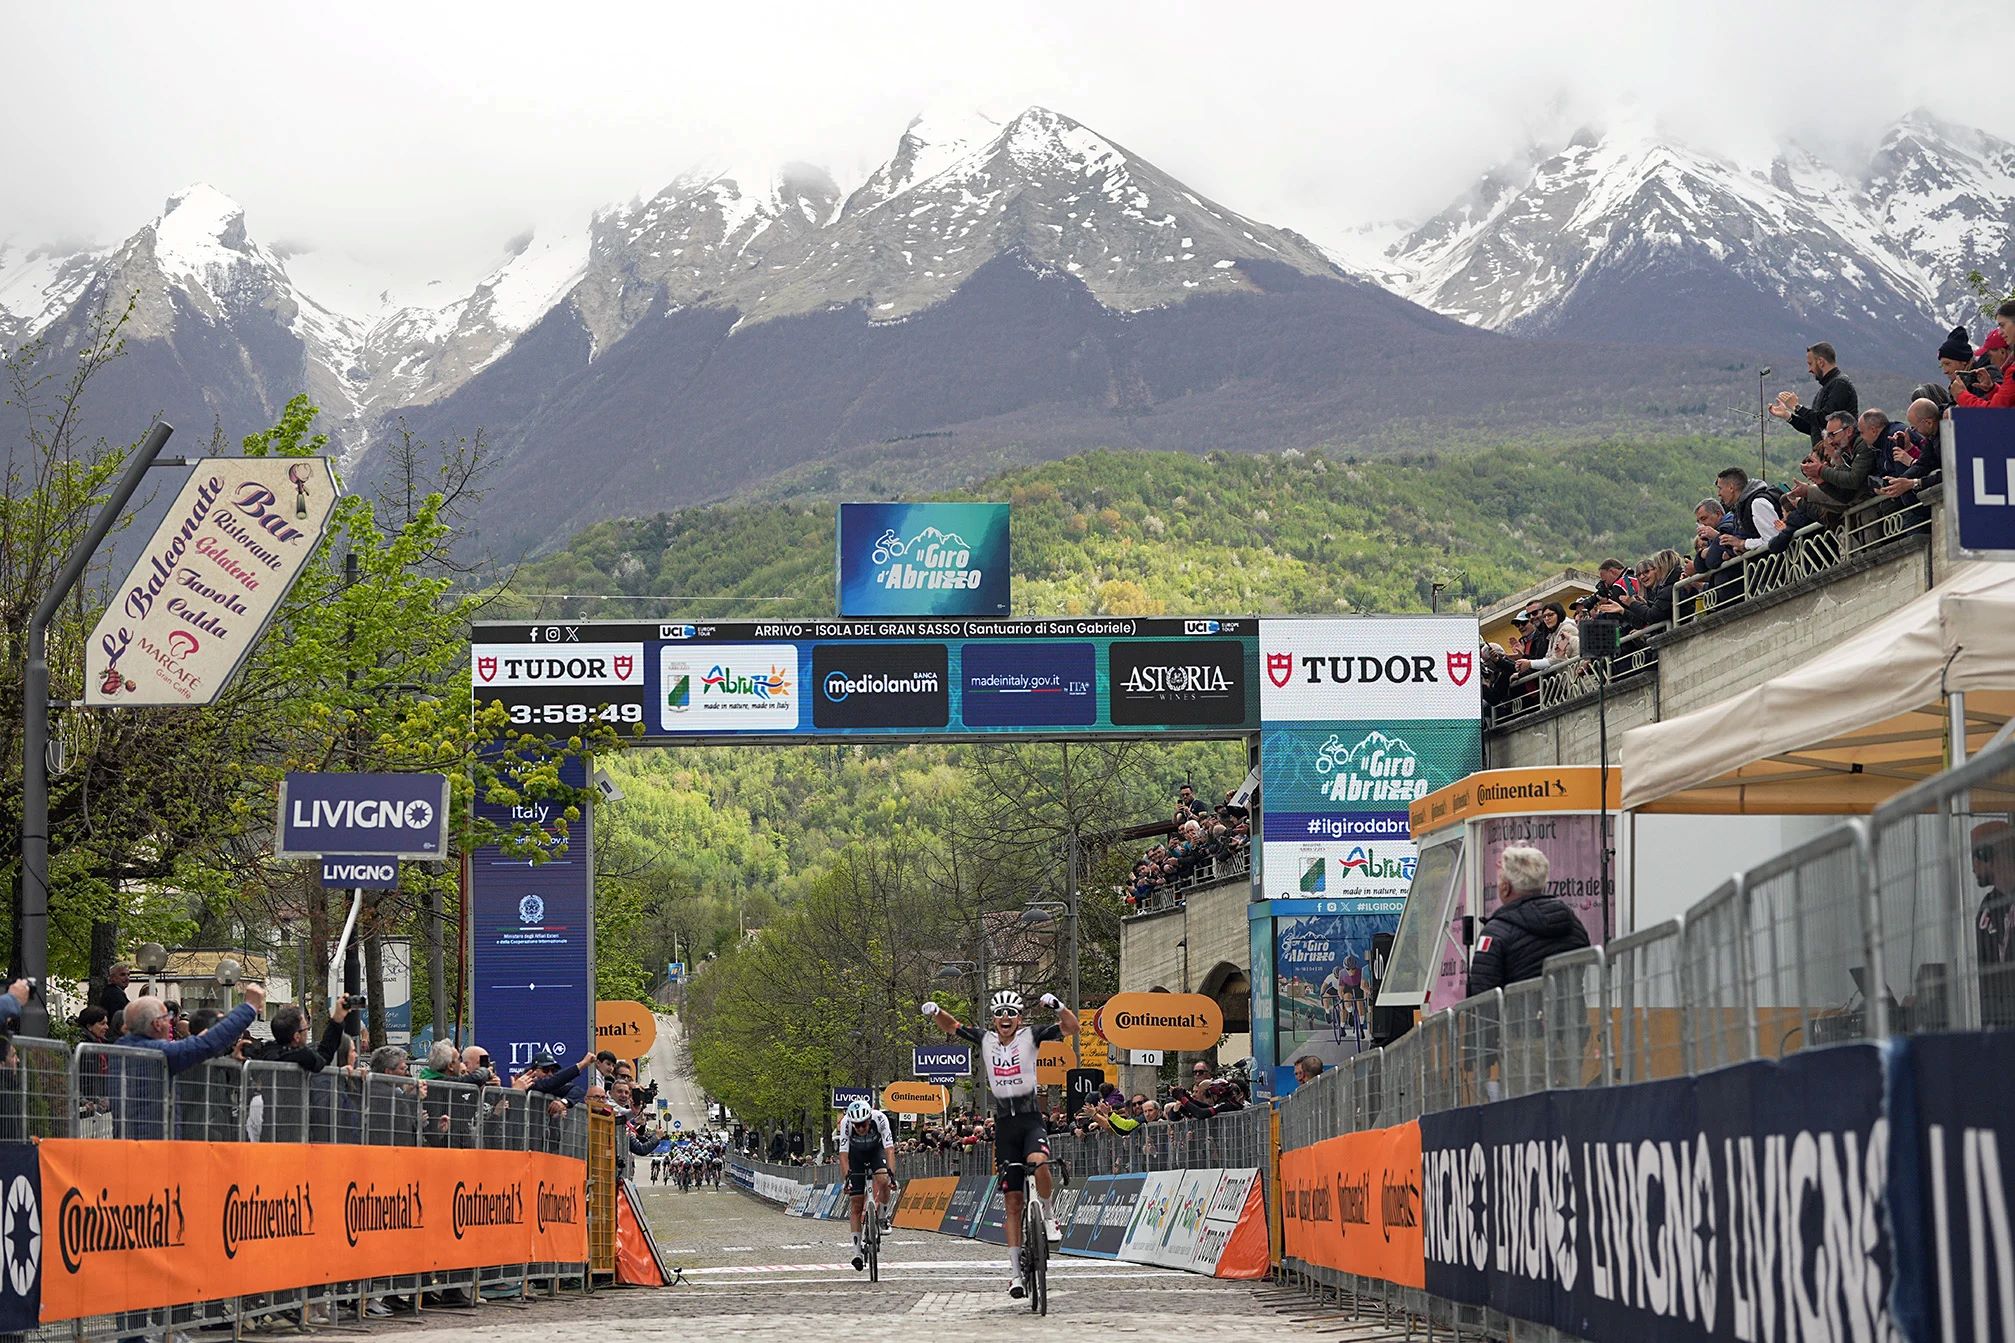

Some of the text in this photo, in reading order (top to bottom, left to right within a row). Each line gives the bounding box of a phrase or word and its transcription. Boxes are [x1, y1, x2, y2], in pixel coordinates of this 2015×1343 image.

[231, 481, 304, 546] Bar
[212, 509, 282, 572] Ristorante
[196, 536, 260, 592] Gelateria
[924, 544, 970, 568] Giro
[101, 476, 224, 670] Le Balconate
[876, 564, 982, 589] d'Abruzzo
[177, 567, 248, 617] Tavola
[167, 598, 228, 640] Calda
[661, 626, 684, 637] UCI
[754, 625, 802, 636] ARRIVO
[815, 625, 852, 636] ISOLA
[854, 624, 877, 636] DEL
[880, 624, 915, 635] GRAN
[919, 623, 960, 635] SASSO
[963, 621, 1032, 637] (Santuario
[1036, 622, 1047, 635] di
[1049, 622, 1074, 635] San
[1077, 620, 1137, 635] Gabriele)
[1186, 622, 1208, 633] UCI
[504, 658, 608, 680] TUDOR
[913, 672, 939, 680] BANCA
[970, 674, 1061, 689] madeinitaly.gov.it
[1123, 666, 1231, 692] ASTORIA
[1302, 655, 1438, 684] TUDOR
[828, 674, 939, 693] mediolanum
[1159, 693, 1197, 701] WINES
[1369, 750, 1417, 778] Giro
[1477, 780, 1551, 806] Continental
[293, 799, 434, 829] LIVIGNO
[323, 865, 395, 880] LIVIGNO
[1115, 1011, 1196, 1029] Continental
[917, 1054, 966, 1066] LIVIGNO
[992, 1054, 1021, 1068] UAE
[1141, 1053, 1155, 1064] 10
[930, 1076, 955, 1084] LIVIGNO
[995, 1078, 1024, 1087] XRG
[891, 1091, 935, 1102] Continental
[223, 1184, 302, 1259] Continental
[345, 1180, 412, 1248] Continental
[452, 1180, 514, 1240] Continental
[1493, 1134, 1579, 1291] LIVIGNO
[60, 1187, 170, 1274] Continental
[1583, 1131, 1717, 1333] LIVIGNO
